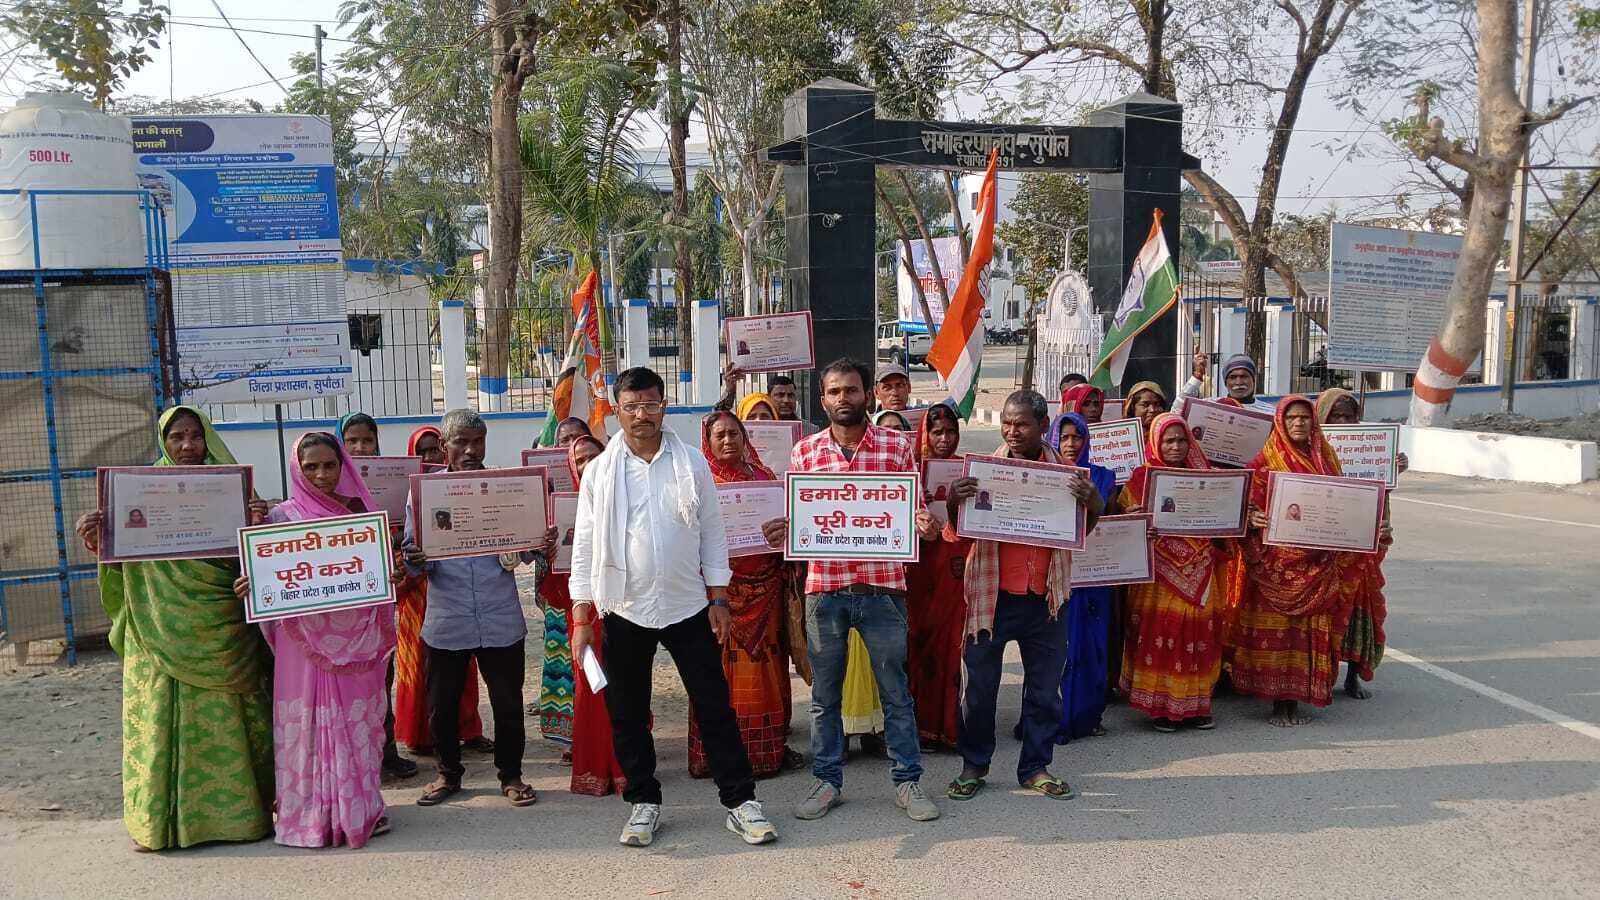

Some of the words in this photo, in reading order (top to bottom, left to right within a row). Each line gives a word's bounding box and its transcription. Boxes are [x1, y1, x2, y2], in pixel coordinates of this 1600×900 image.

[131, 127, 144, 135] ना
[146, 125, 159, 135] की
[160, 127, 183, 136] सतत्
[135, 139, 166, 149] प्रणाली
[29, 150, 52, 163] 500
[54, 151, 73, 163] Ltr.
[957, 154, 1015, 168] स्थापित-991
[249, 379, 273, 393] जिला
[275, 379, 312, 392] प्रशासन,
[314, 377, 345, 393] सुपौल।
[799, 483, 859, 502] हमारी
[862, 484, 908, 502] मांगे
[813, 510, 848, 534] पूरी
[851, 511, 894, 529] करो
[255, 531, 323, 558] हमारी
[326, 525, 377, 547] मांगे
[815, 533, 833, 545] बिहार
[835, 533, 851, 546] प्रदेश
[852, 535, 865, 547] युवा
[866, 532, 888, 545] कांग्रेस
[274, 561, 315, 590] पूरी
[317, 555, 364, 577] करो
[280, 588, 300, 601] बिहार
[302, 585, 320, 599] प्रदेश
[321, 585, 336, 598] युवा
[337, 581, 361, 594] कांग्रेस
